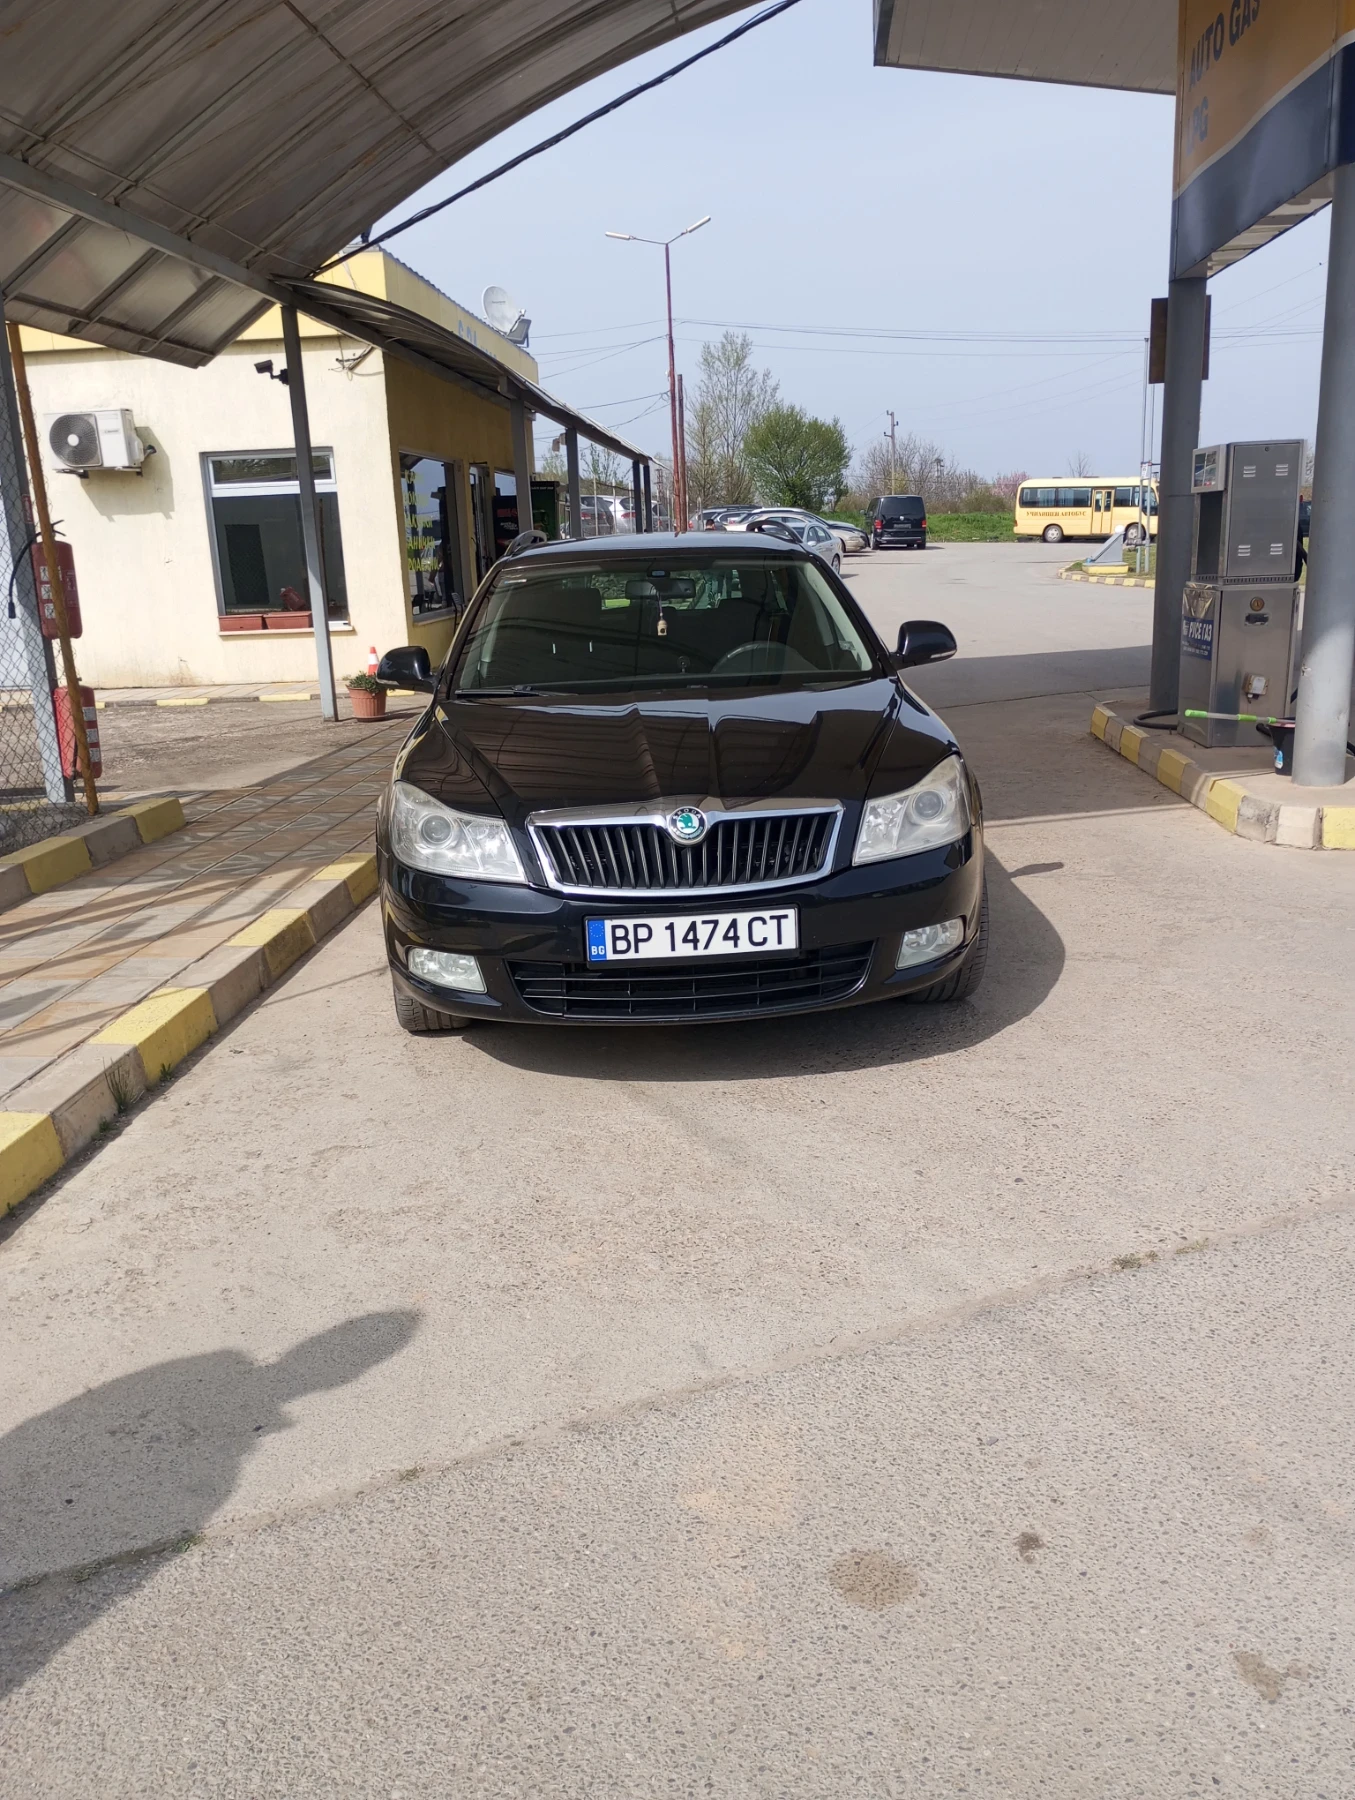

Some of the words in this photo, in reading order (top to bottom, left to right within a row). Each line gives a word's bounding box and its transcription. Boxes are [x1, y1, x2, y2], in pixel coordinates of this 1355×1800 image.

[1189, 12, 1224, 92] AUTO
[591, 945, 605, 956] BG
[611, 923, 653, 955] BP
[664, 918, 740, 952] 1474
[747, 914, 789, 947] CT
